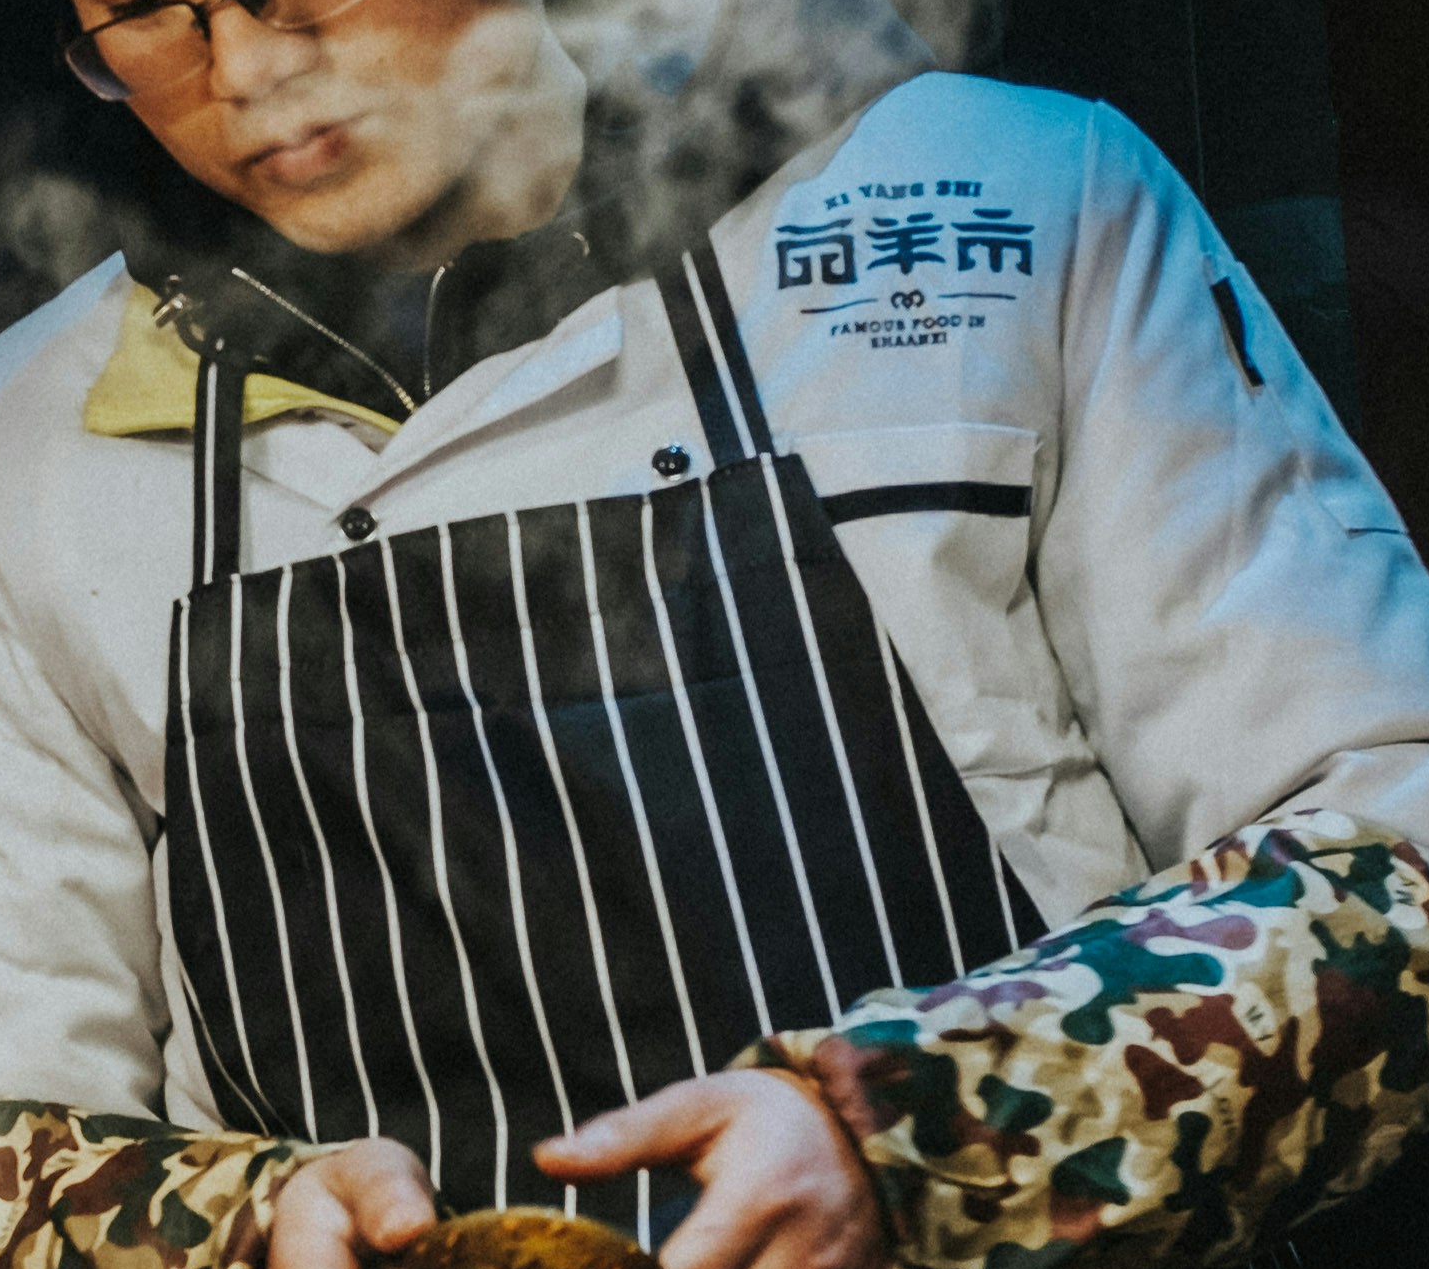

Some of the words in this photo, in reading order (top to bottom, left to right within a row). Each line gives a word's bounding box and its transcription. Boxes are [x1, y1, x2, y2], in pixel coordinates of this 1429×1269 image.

[824, 192, 850, 211] XI
[858, 182, 924, 200] YANG
[936, 179, 982, 197] SHI
[830, 318, 906, 337] FAMOUS
[912, 314, 962, 330] FOOD
